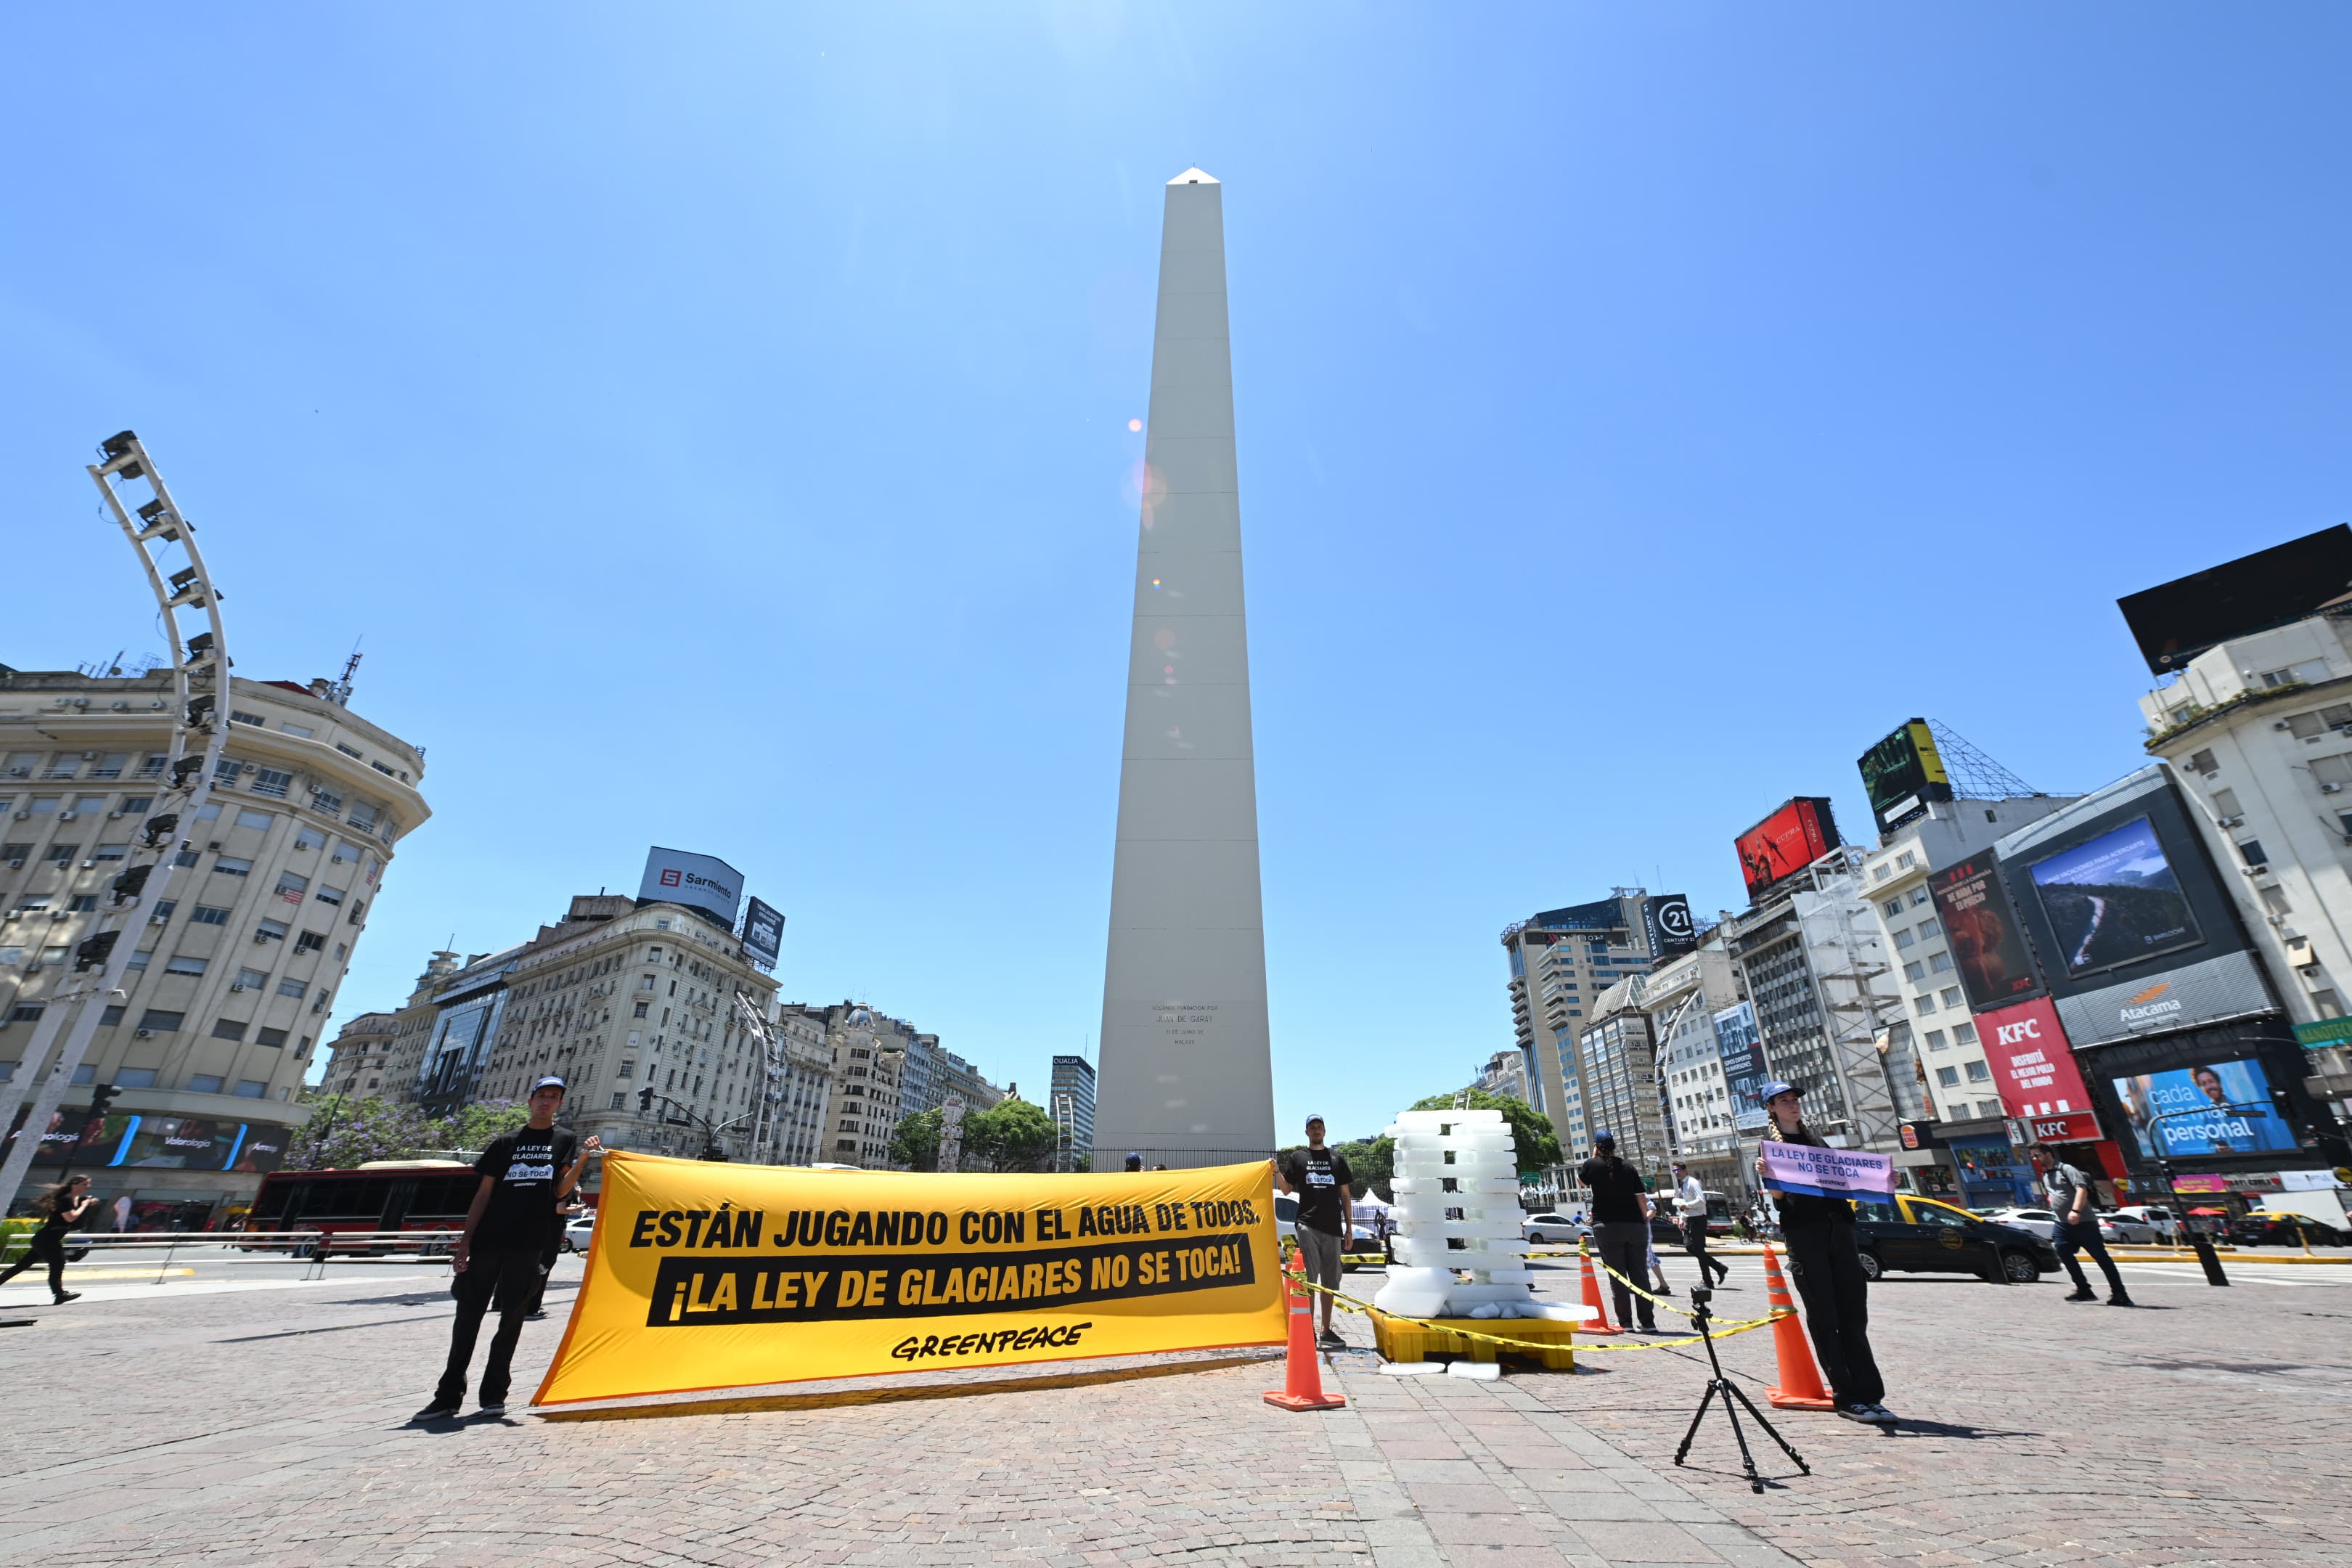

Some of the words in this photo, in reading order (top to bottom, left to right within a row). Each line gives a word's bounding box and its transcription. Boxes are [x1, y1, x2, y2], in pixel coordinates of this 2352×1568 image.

[1776, 825, 1800, 844] CUPRA
[1808, 819, 1817, 843] CUPRA
[685, 873, 732, 899] Sarmiento
[1971, 880, 1986, 892] POR
[1645, 915, 1657, 956] CENTURY
[2012, 978, 2032, 991] KFC
[2120, 1000, 2182, 1022] Atacama
[1996, 1018, 2041, 1045] KFC
[1735, 1053, 1752, 1063] EXPERTOS
[2010, 1048, 2046, 1068] DISFRUTÁ
[2009, 1069, 2019, 1079] EL
[2017, 1066, 2037, 1078] MEJOR
[2035, 1063, 2056, 1074] POLLO
[2020, 1079, 2033, 1089] DEL
[2030, 1076, 2053, 1087] MUNDO
[2149, 1084, 2196, 1105] cada
[2035, 1121, 2068, 1138] KFC
[2163, 1116, 2255, 1146] personal
[1772, 1148, 1784, 1158] LA
[1787, 1150, 1805, 1161] LEY
[1808, 1152, 1822, 1162] DE
[1824, 1154, 1882, 1169] GLACIARES
[1798, 1161, 1813, 1172] NO
[1816, 1164, 1829, 1175] SE
[1832, 1166, 1860, 1178] TOCA
[629, 1203, 764, 1248] ESTÁN
[774, 1210, 947, 1247] JUGANDO
[960, 1211, 1024, 1245] CON
[1037, 1209, 1071, 1242] EL
[1077, 1205, 1151, 1238] AGUA
[1156, 1201, 1188, 1232] DE
[1190, 1199, 1260, 1229] TODOS.
[669, 1272, 738, 1321] ¡LA
[751, 1271, 828, 1310] LEY
[837, 1270, 888, 1308] DE
[898, 1258, 1082, 1306] GLACIARES
[1090, 1254, 1130, 1291] NO
[1138, 1251, 1170, 1285] SE
[1175, 1244, 1241, 1282] TOCA!
[891, 1322, 1093, 1362] GREENPEACE
